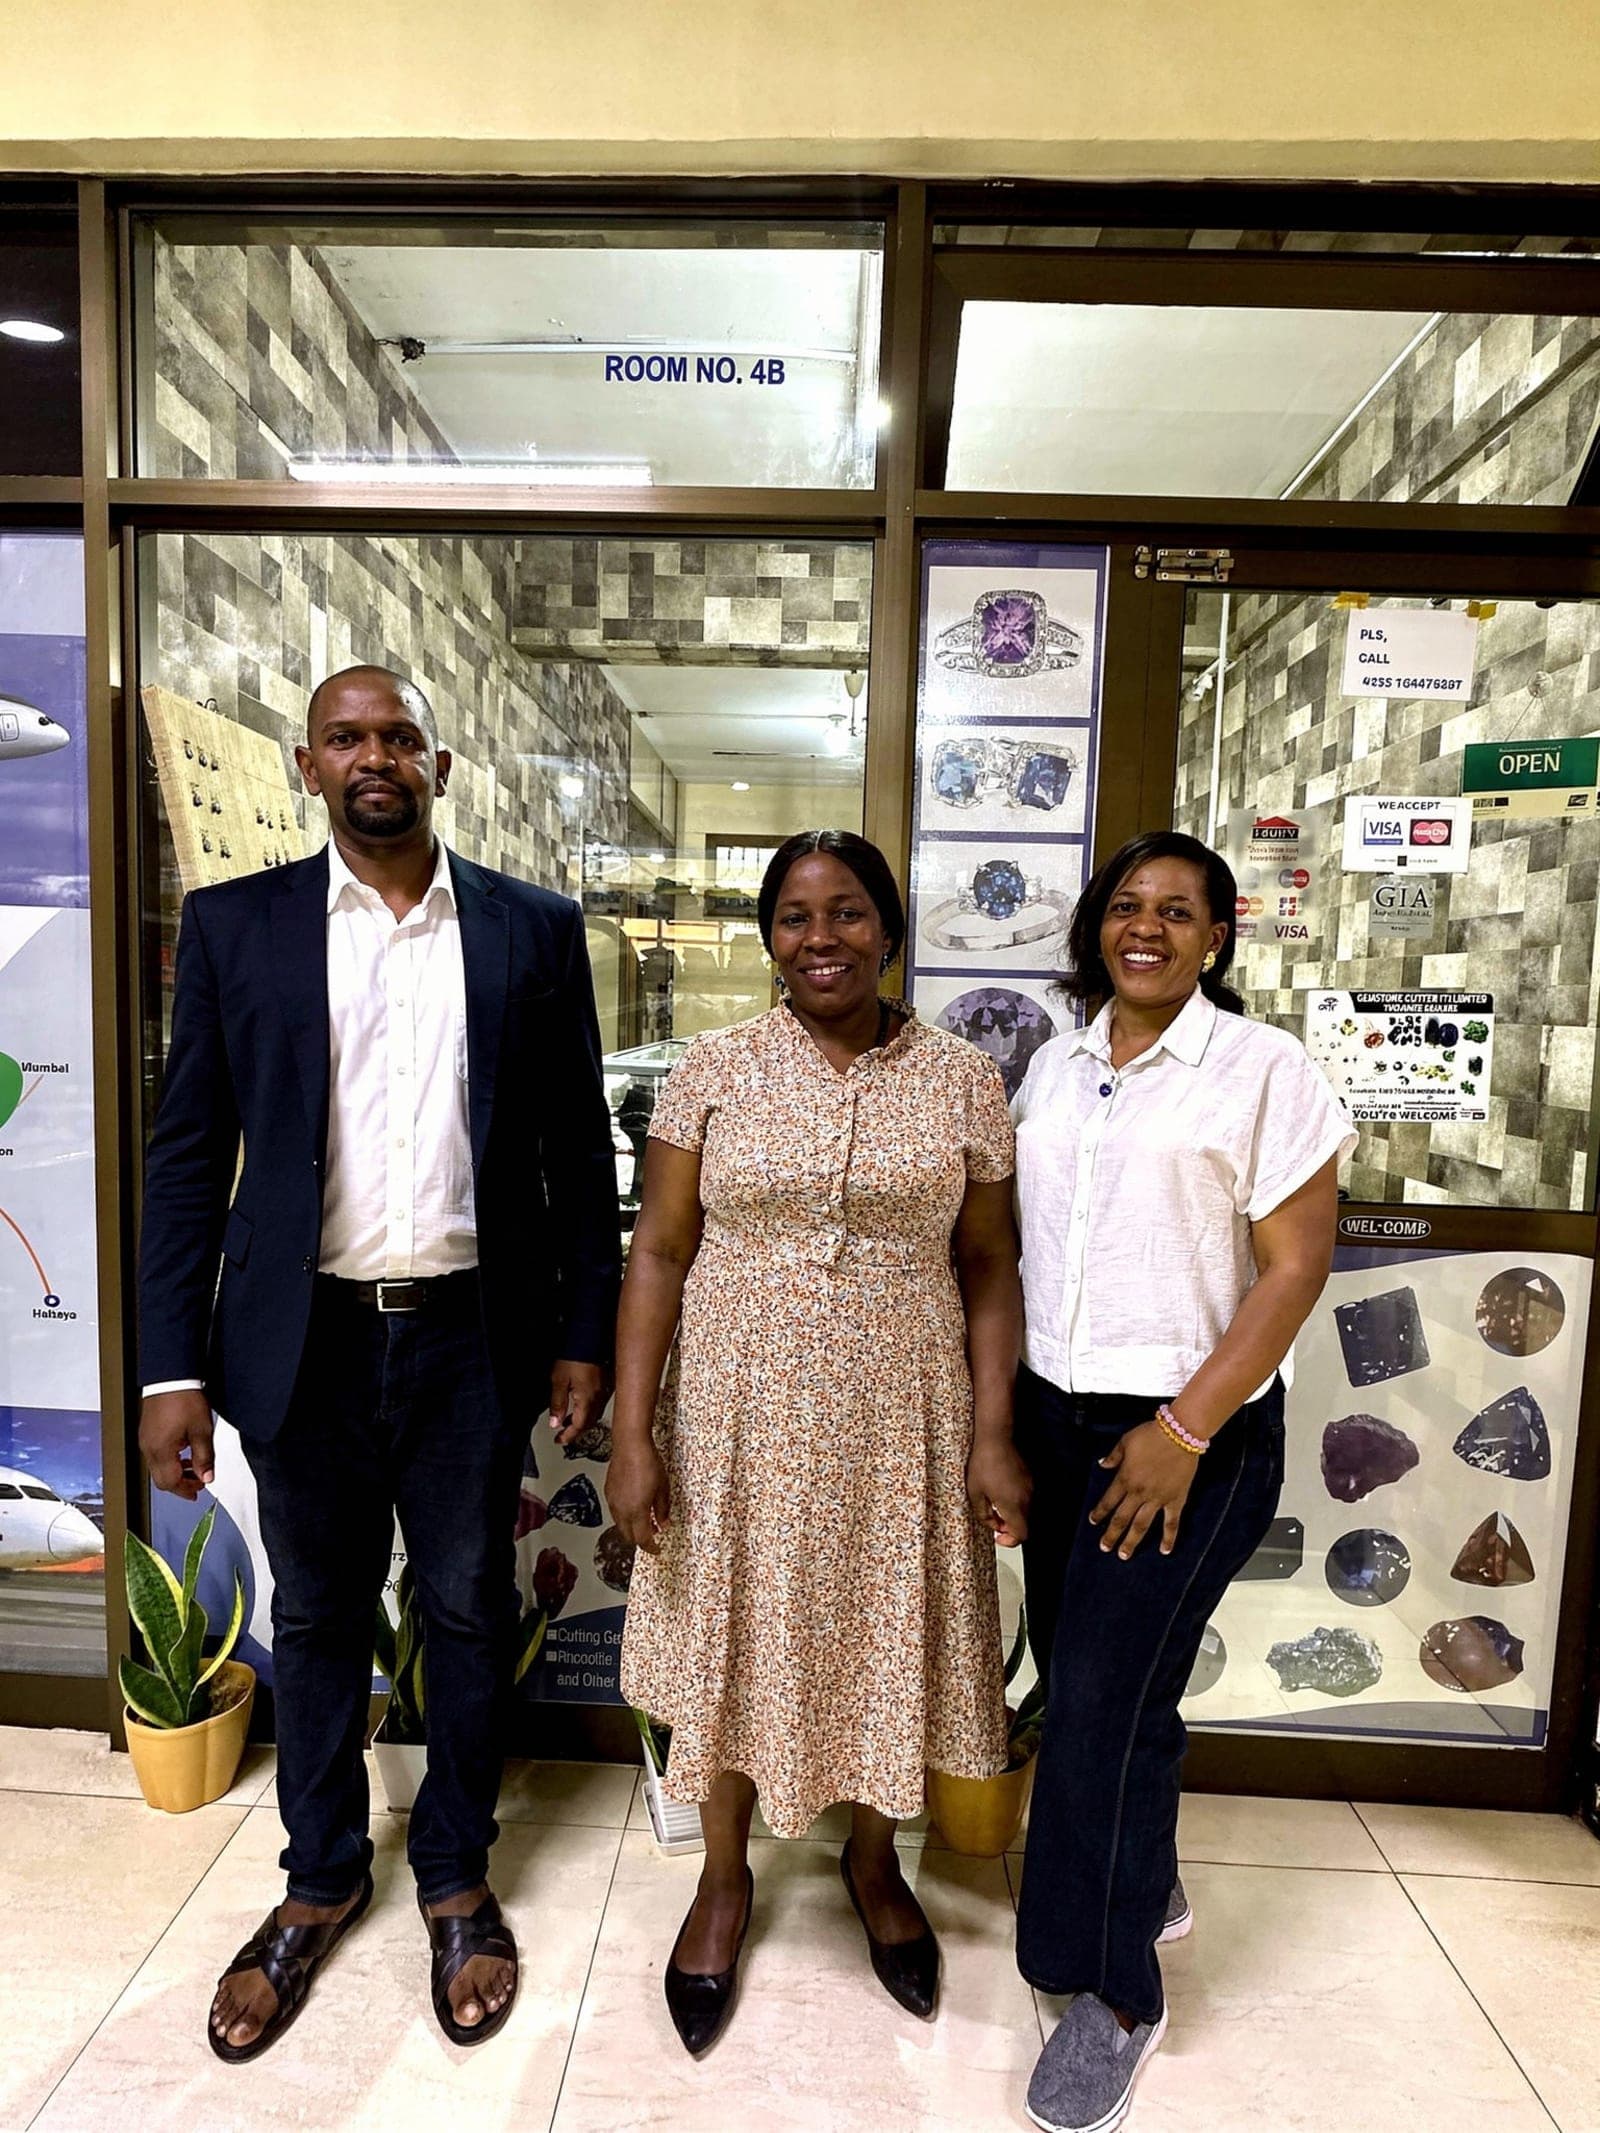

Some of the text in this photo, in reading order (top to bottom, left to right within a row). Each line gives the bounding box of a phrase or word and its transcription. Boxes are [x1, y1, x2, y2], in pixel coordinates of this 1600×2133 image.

[605, 355, 785, 384] ROOM NO. 4B
[1360, 629, 1387, 643] PLS,
[1359, 653, 1390, 664] CALL
[1499, 752, 1560, 775] OPEN
[1369, 821, 1401, 835] VISA
[1375, 885, 1429, 908] GIA
[1275, 925, 1308, 939] VISA
[1400, 1111, 1457, 1121] WELCOME
[558, 1628, 600, 1645] Cutting
[557, 1672, 615, 1688] and Other
